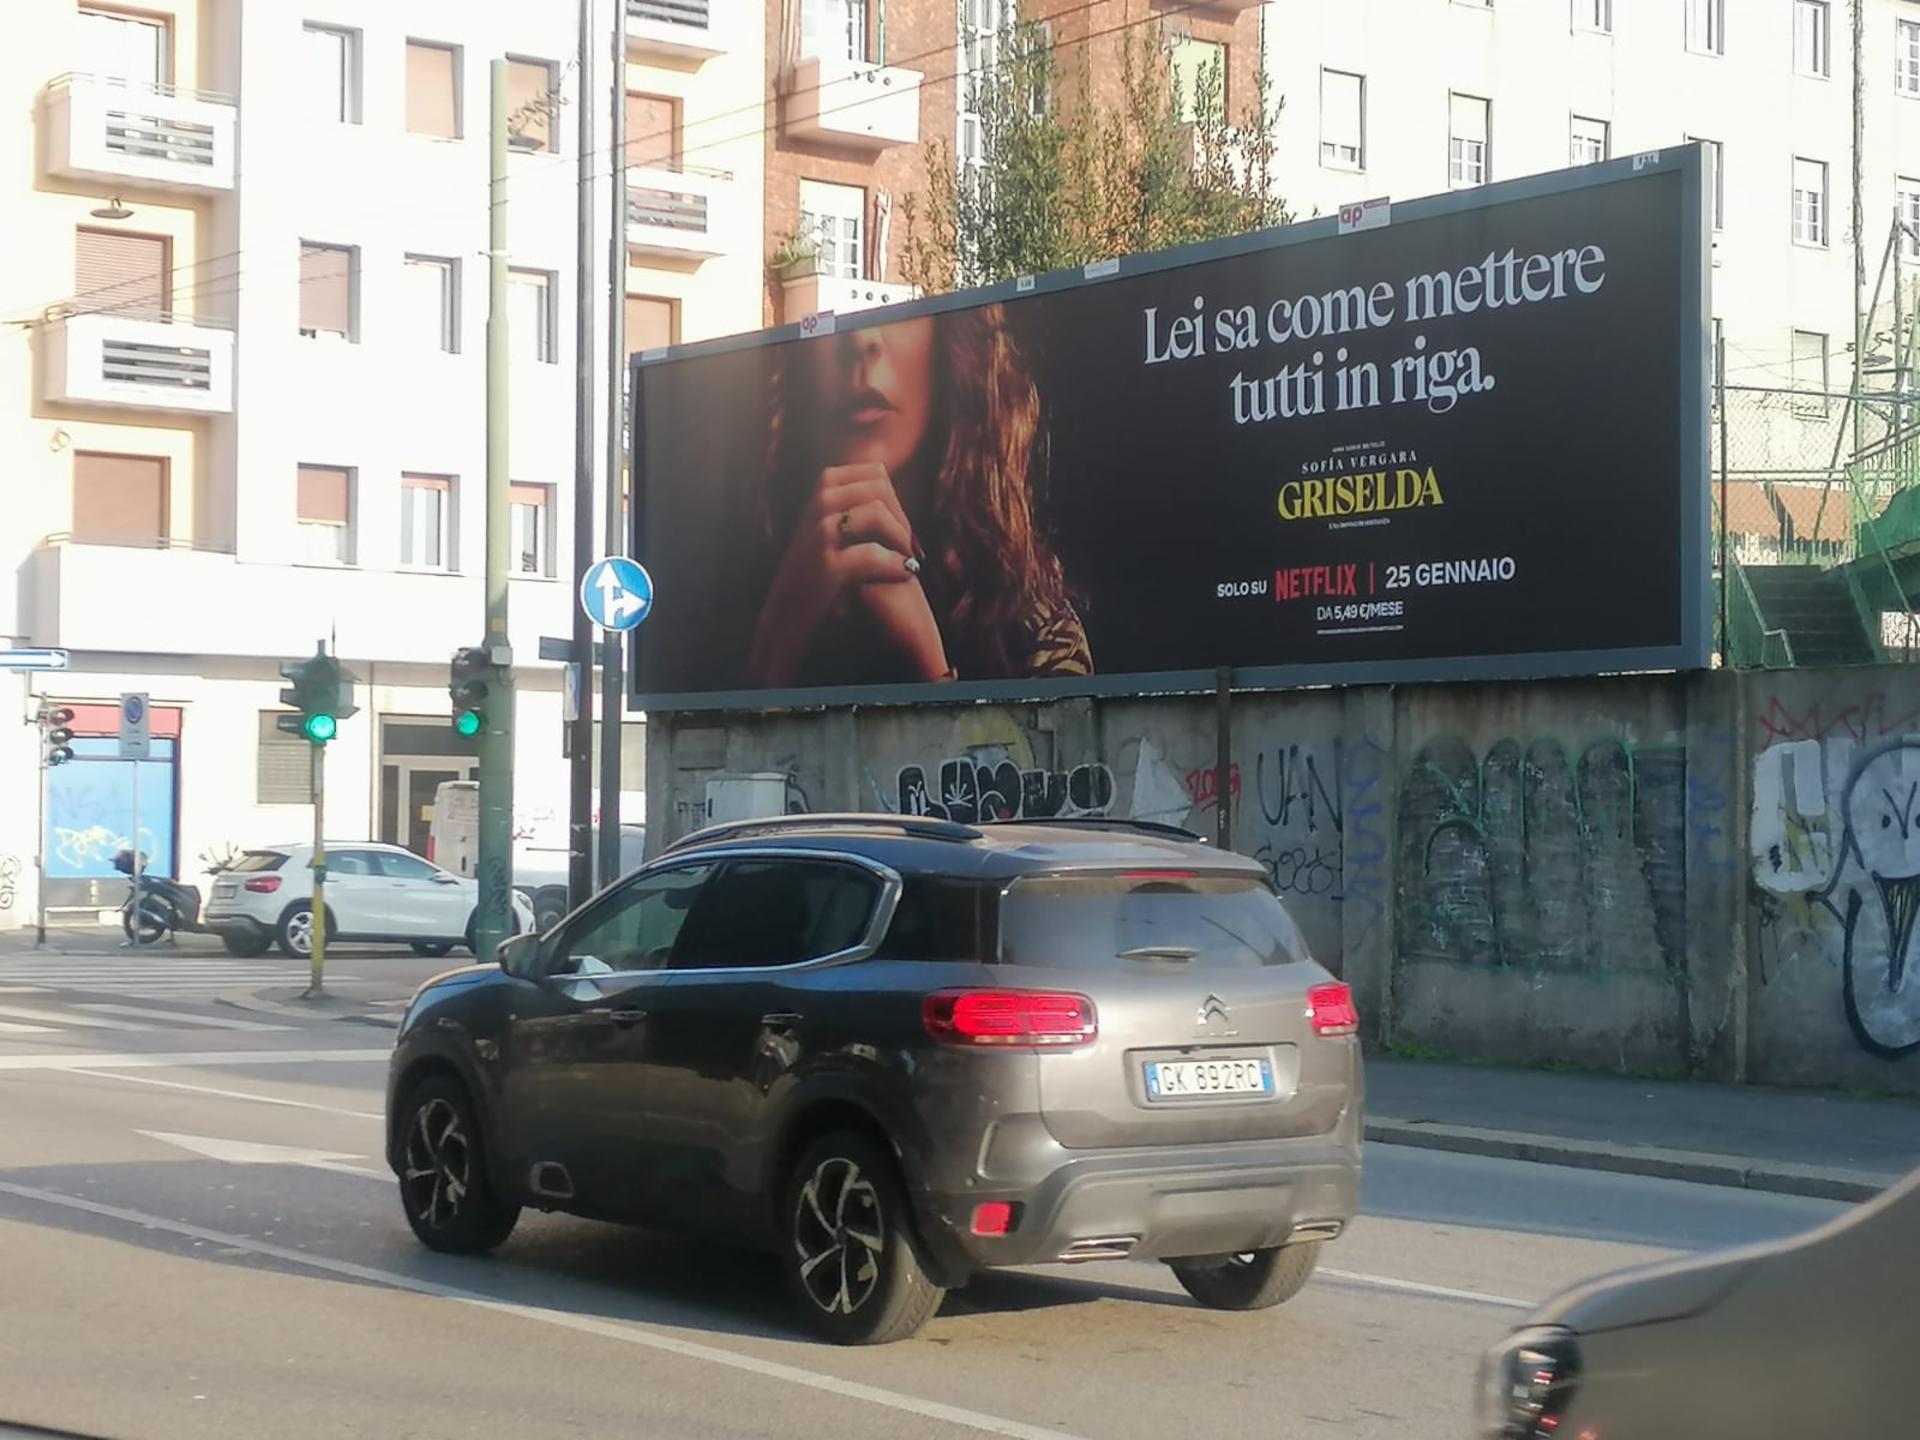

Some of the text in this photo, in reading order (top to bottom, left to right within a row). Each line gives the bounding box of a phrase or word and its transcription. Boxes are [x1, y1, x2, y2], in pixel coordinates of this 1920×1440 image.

[1144, 245, 1605, 364] Lei sa come mettere
[1230, 336, 1495, 424] tutti in riga.
[1301, 450, 1417, 474] SOFÍA VERGARA
[1277, 466, 1444, 520] GRISELDA
[1217, 557, 1516, 601] SOLO SU NETFLIX 25 GENNAIO
[1316, 606, 1333, 621] DA
[1333, 604, 1358, 620] 5,49
